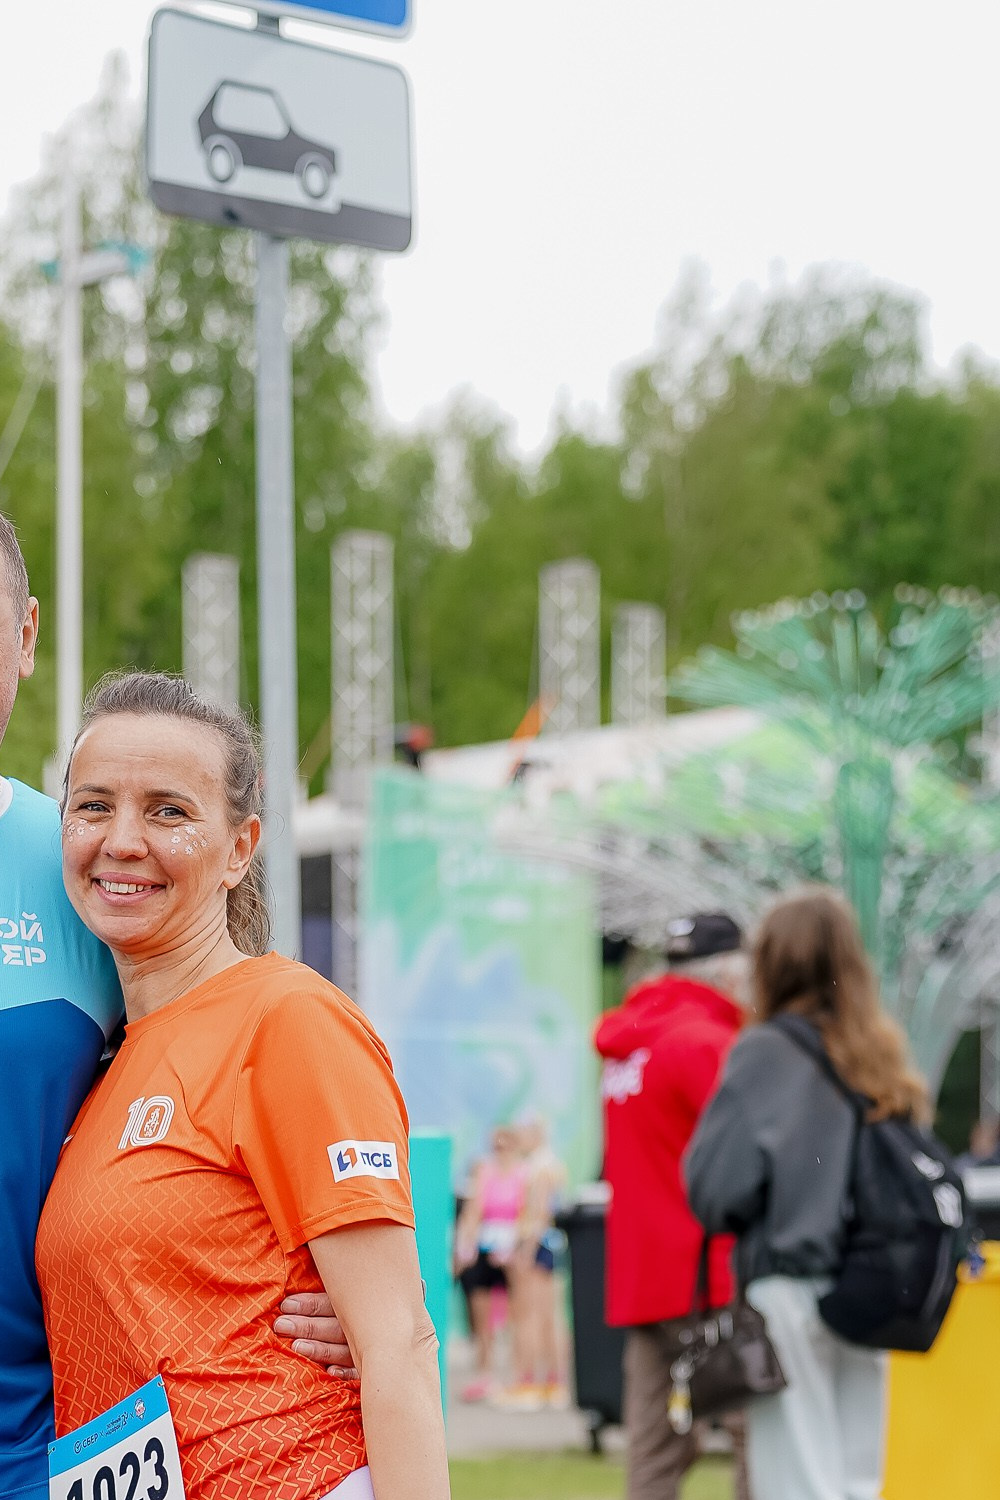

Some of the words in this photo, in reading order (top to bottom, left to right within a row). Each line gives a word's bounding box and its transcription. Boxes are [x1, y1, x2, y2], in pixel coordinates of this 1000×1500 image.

[117, 1095, 175, 1150] 10
[360, 1152, 392, 1168] ПСБ
[82, 1433, 99, 1448] СБЕР
